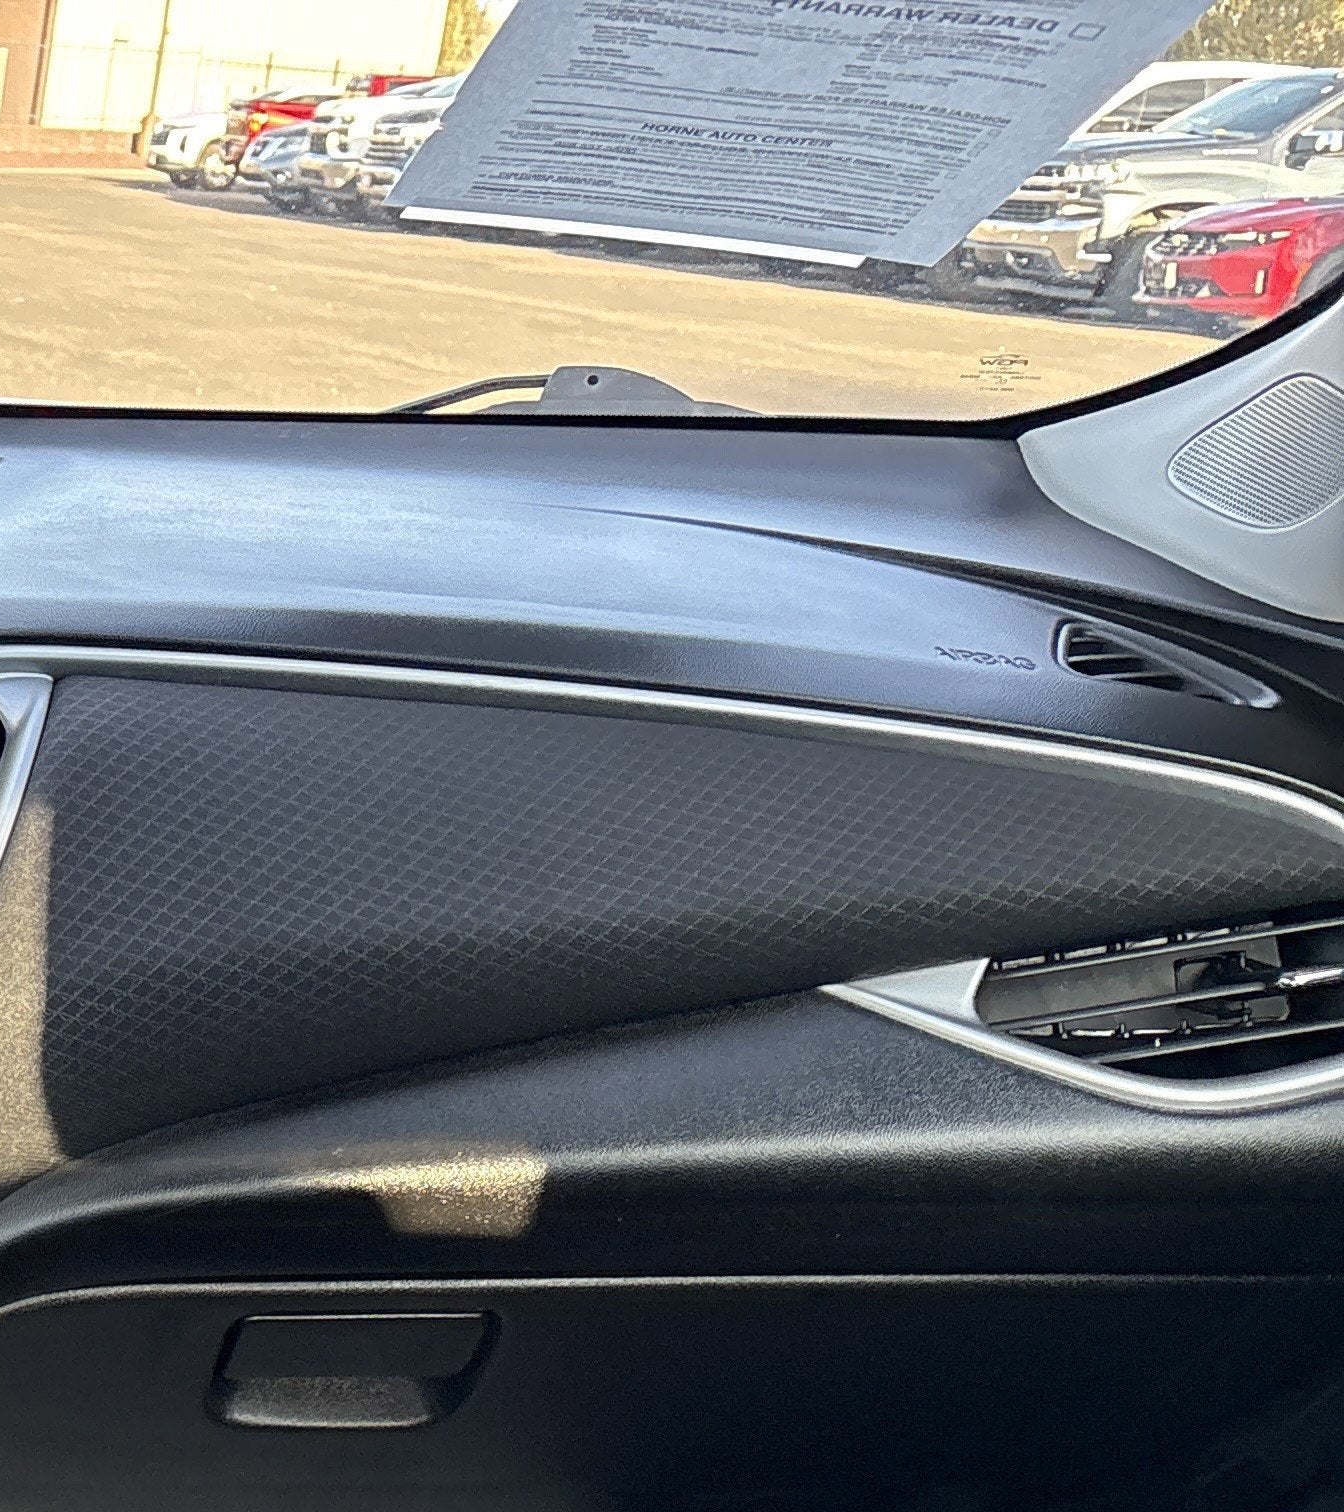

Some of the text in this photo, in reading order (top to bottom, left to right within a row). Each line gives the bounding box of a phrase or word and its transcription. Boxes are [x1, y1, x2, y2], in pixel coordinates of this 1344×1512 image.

[641, 122, 703, 137] HORNE
[708, 129, 758, 143] AUTO
[761, 134, 834, 148] CENTER
